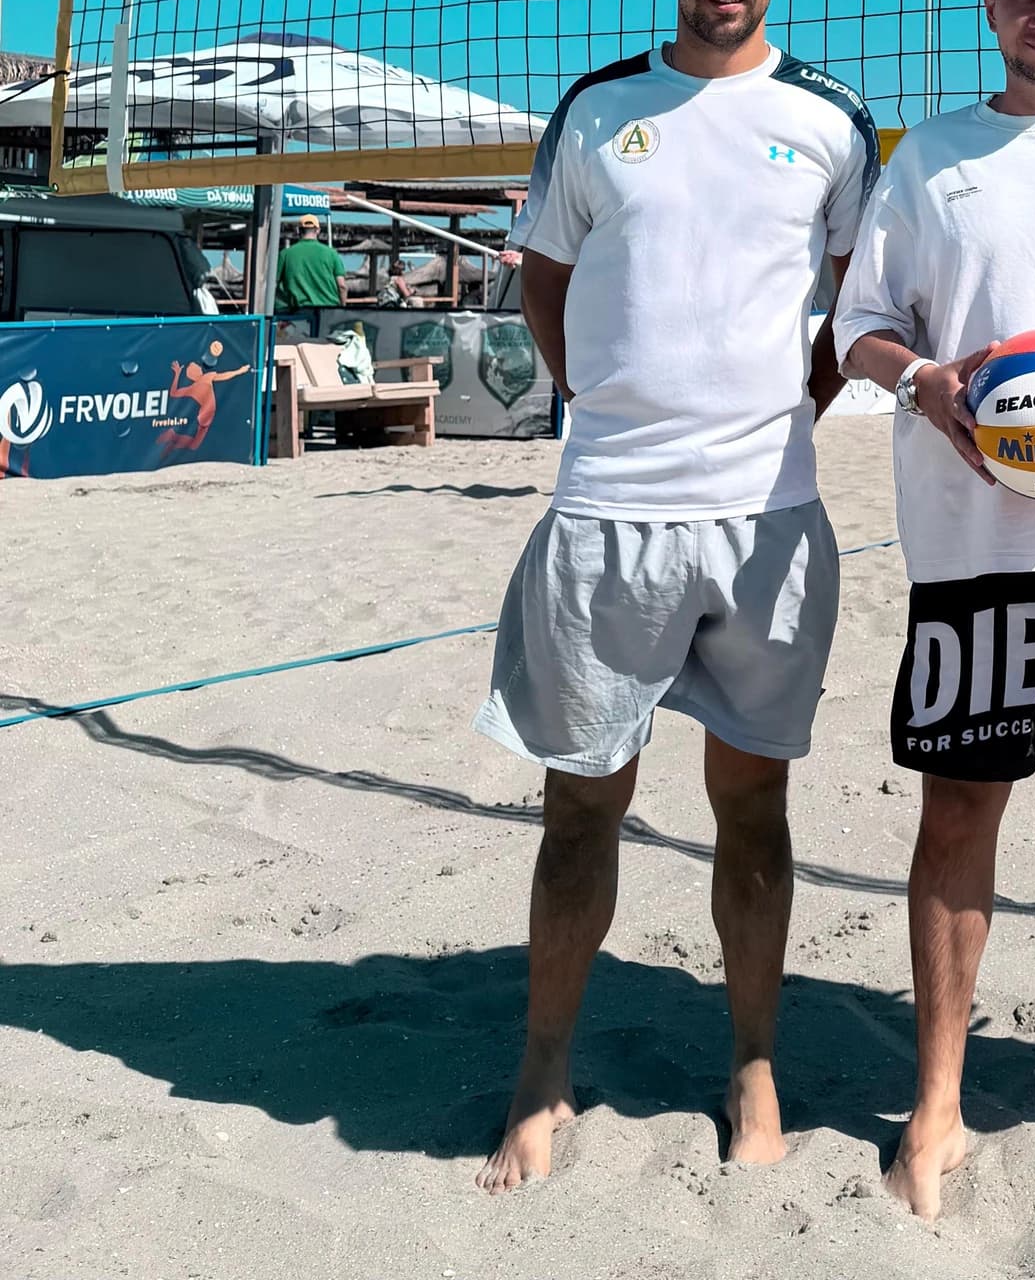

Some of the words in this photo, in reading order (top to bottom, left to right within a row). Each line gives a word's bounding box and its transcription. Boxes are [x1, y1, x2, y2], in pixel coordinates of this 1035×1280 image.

[800, 68, 868, 118] UNDER
[284, 193, 330, 208] TUBORG
[59, 390, 169, 424] FRVOLEI
[435, 414, 472, 424] CADEMY
[906, 734, 951, 752] FOR
